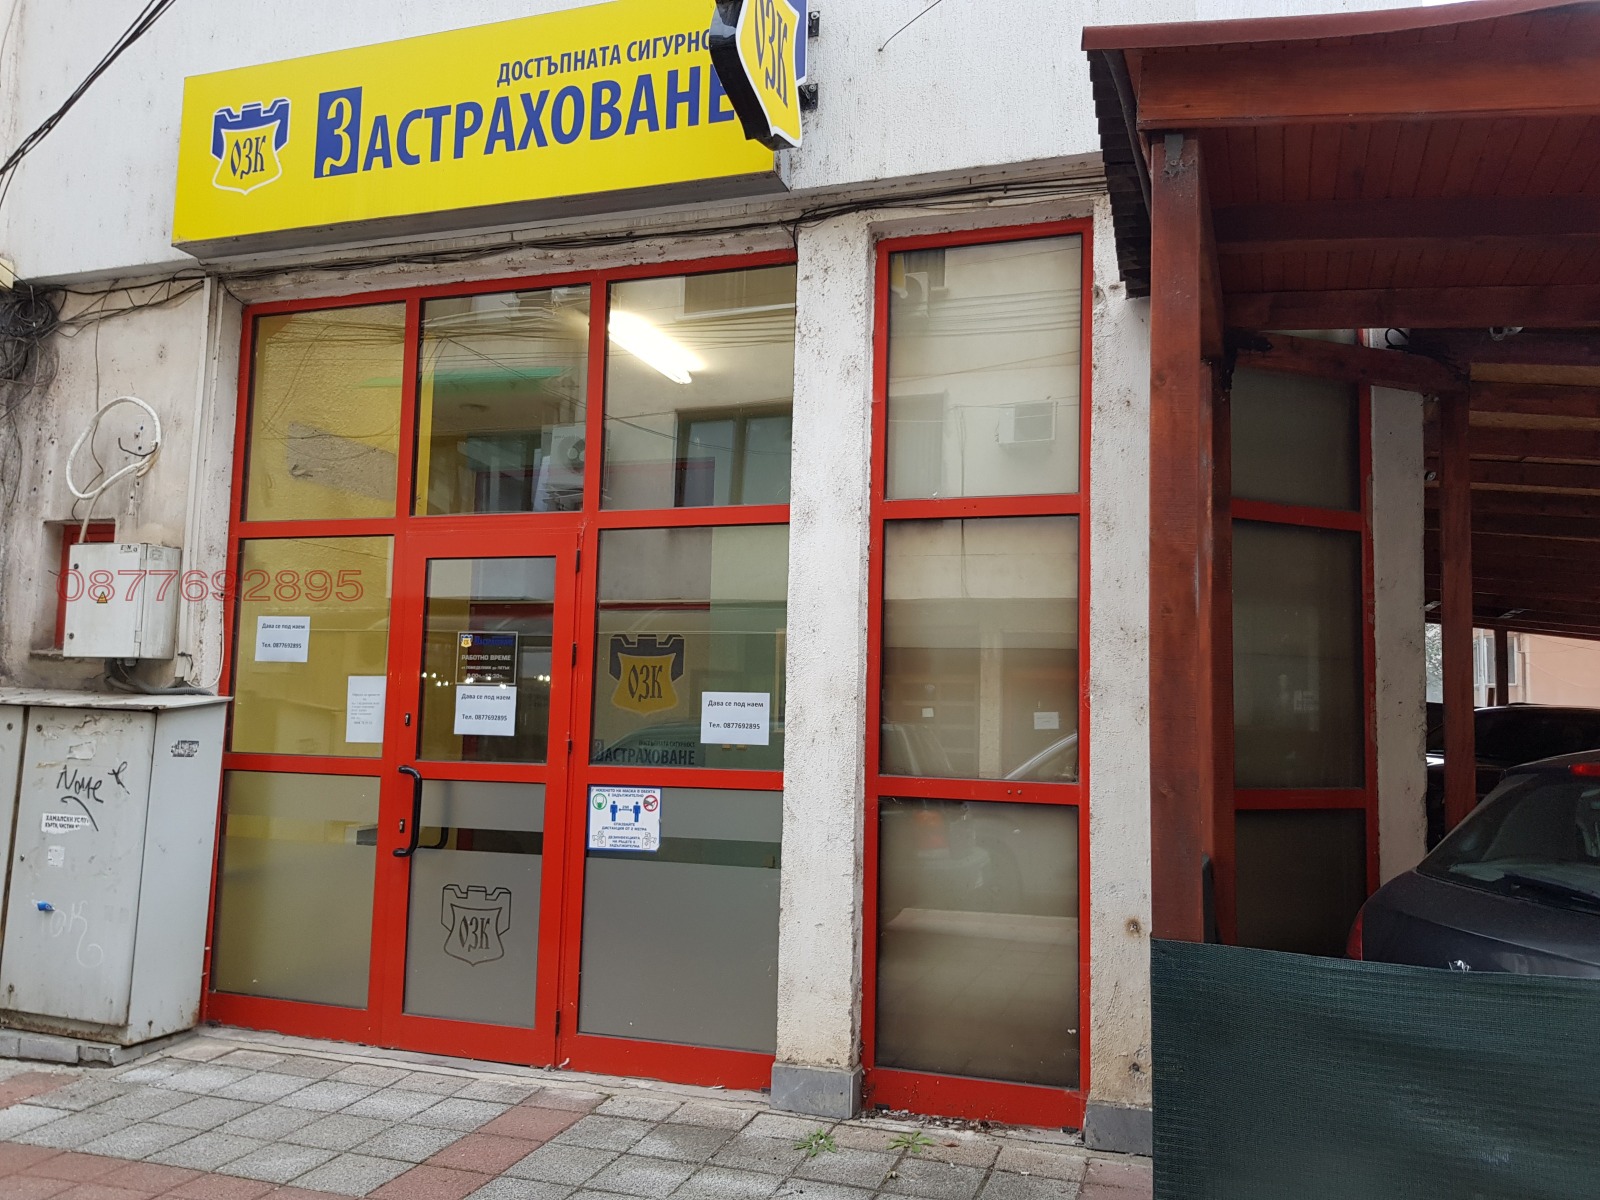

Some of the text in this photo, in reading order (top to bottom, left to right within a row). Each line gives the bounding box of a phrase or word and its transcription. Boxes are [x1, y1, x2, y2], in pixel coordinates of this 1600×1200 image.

[497, 44, 621, 87] ДОСТЪПНАТА
[318, 64, 735, 177] ЗАСТРАХОВАНЕ
[230, 135, 267, 179] ОЗК
[628, 664, 663, 702] ОЗК
[459, 915, 490, 952] ОЗК
